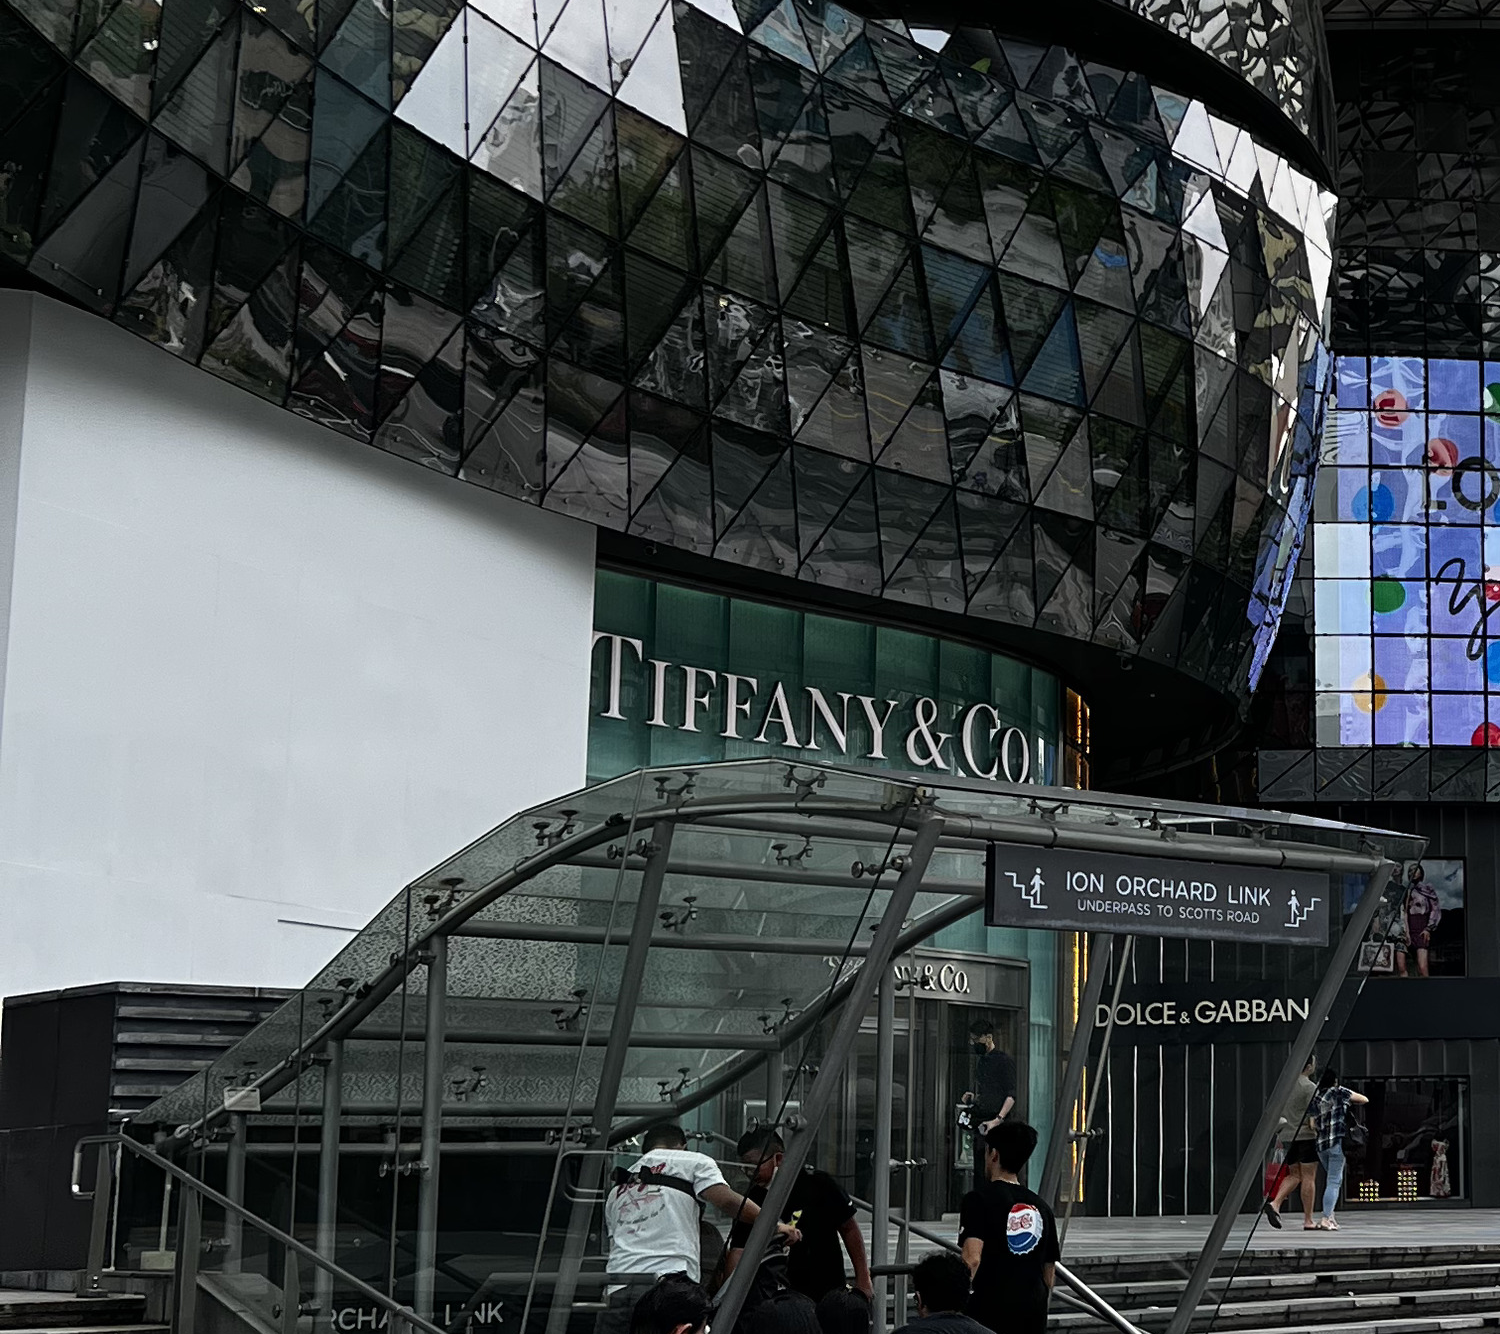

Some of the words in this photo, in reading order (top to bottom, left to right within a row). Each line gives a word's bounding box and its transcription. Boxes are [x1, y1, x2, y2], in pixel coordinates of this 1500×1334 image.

[592, 630, 899, 759] TIFFANY
[906, 697, 953, 770] &
[1066, 870, 1104, 894] ION
[1116, 875, 1217, 902] ORCHARD
[1228, 884, 1271, 907] LINK
[1077, 898, 1151, 916] UNDERPASS
[1157, 904, 1174, 918] TO
[1179, 907, 1223, 922] SCOTTS
[1226, 910, 1260, 924] ROAD
[1094, 1001, 1176, 1028] DOLCE
[1179, 1011, 1191, 1025] &
[1194, 997, 1329, 1025] GABBAN
[444, 1301, 504, 1326] LNK
